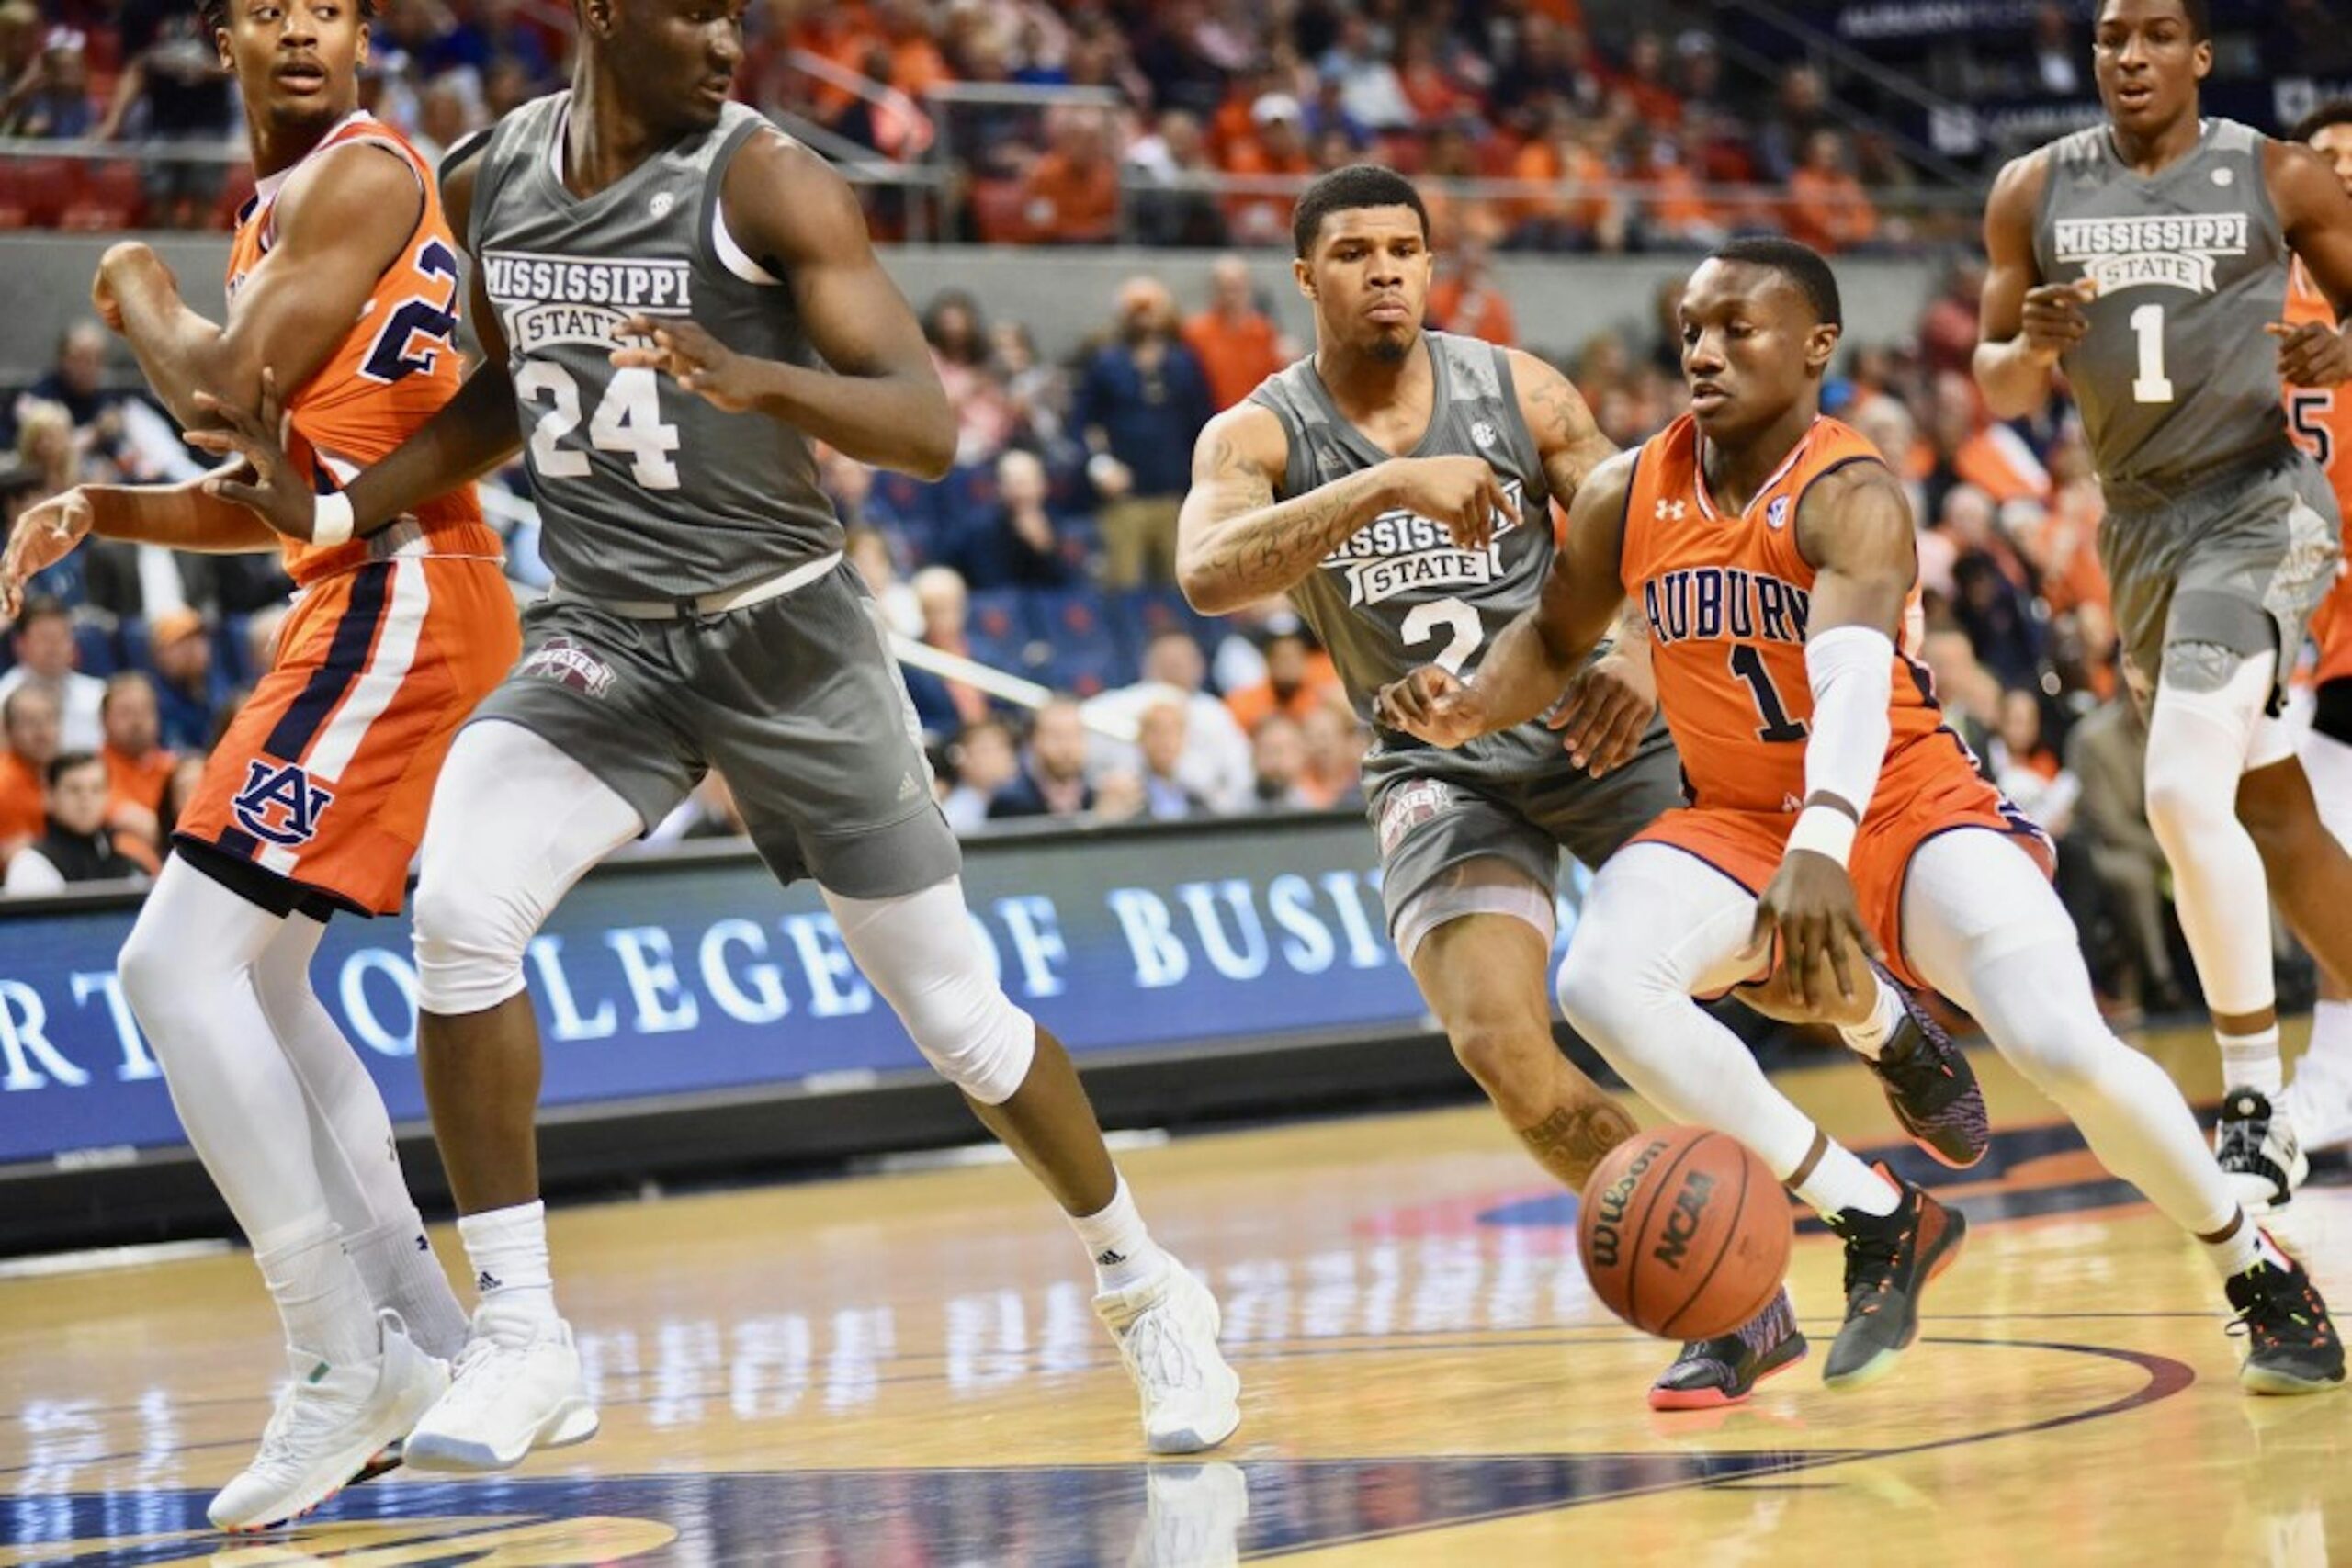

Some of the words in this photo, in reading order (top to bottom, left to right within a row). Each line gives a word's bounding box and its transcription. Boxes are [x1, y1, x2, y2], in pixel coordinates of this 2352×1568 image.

[482, 256, 691, 307] MISSISSIPPI
[2055, 219, 2248, 254] MISSISSIPPI
[2106, 257, 2191, 286] STATE
[2129, 303, 2175, 404] 1
[514, 360, 681, 491] 24
[1373, 555, 1478, 593] STATE
[1399, 596, 1486, 687] 2
[1727, 642, 1812, 743] 1
[232, 759, 334, 845] AU
[338, 910, 874, 1056] OLEGE
[1592, 1140, 1670, 1269] Wilson
[1653, 1168, 1714, 1272] NCAA
